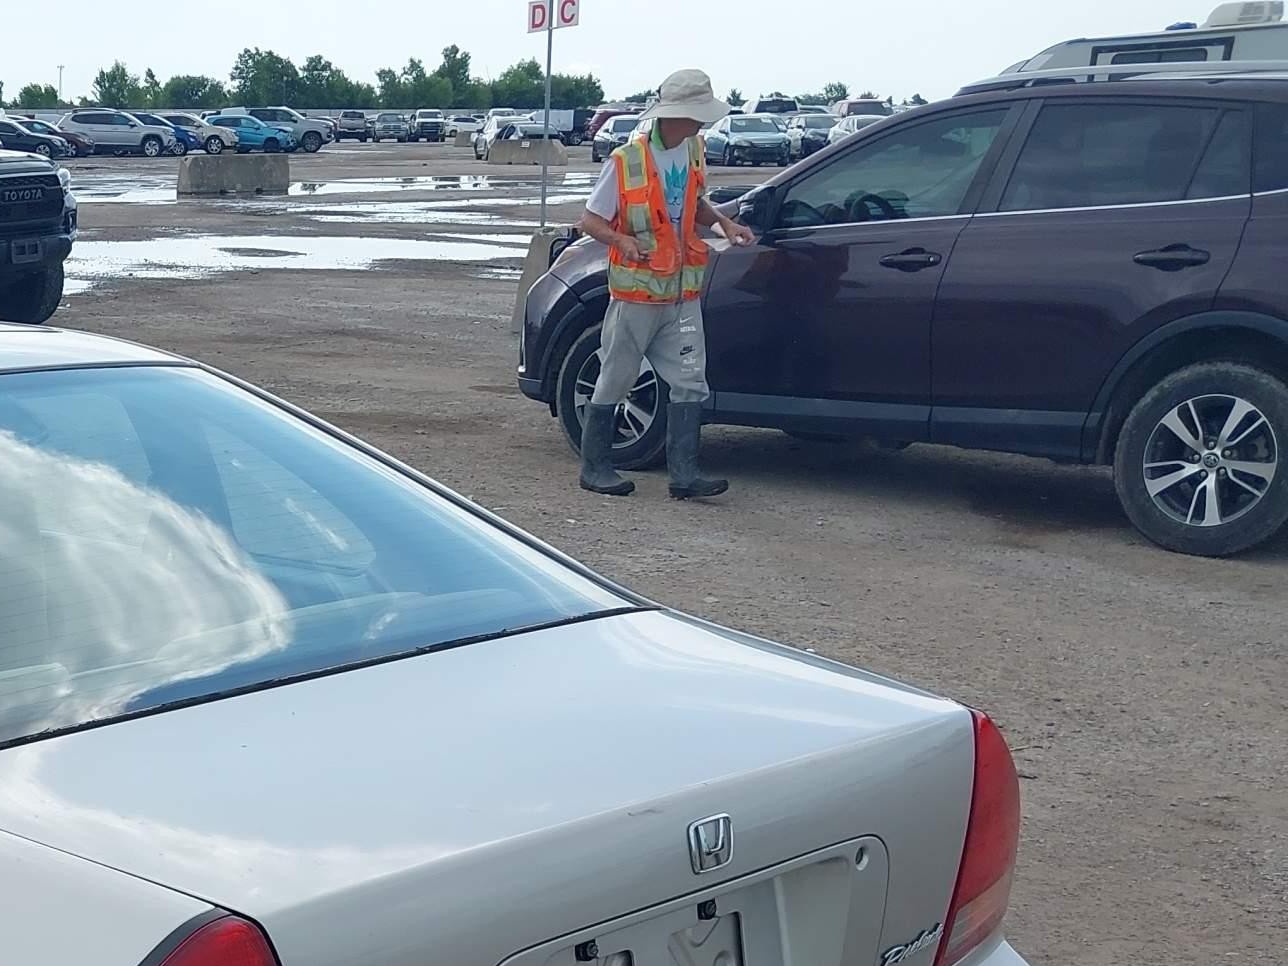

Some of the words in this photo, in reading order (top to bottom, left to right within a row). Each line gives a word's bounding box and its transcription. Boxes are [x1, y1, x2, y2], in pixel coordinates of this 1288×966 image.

[531, 4, 546, 29] D
[560, 0, 576, 24] C
[4, 189, 43, 201] TOYOTA
